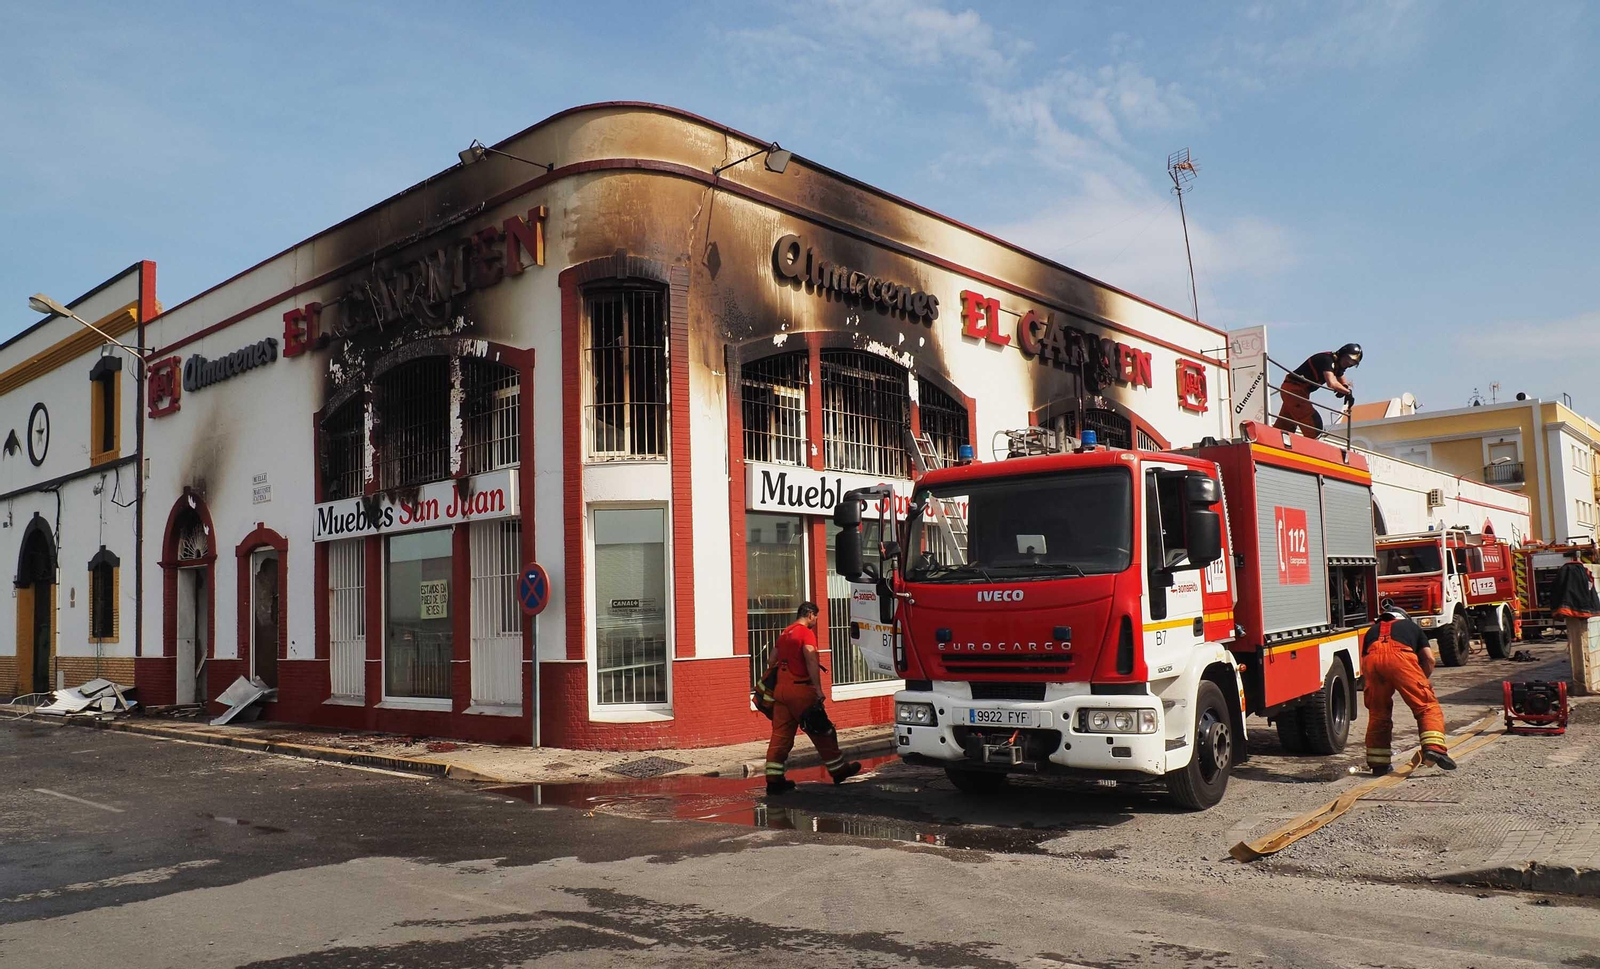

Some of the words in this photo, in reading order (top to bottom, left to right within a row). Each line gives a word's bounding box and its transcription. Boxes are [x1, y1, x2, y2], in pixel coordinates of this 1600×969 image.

[960, 290, 1011, 346] EL
[283, 302, 330, 358] EL
[1289, 528, 1305, 553] 112
[1213, 560, 1224, 574] 112
[977, 589, 1024, 602] IVECO
[883, 634, 892, 647] B7
[1156, 631, 1167, 645] B7
[938, 642, 1071, 650] EUROCARGO
[977, 711, 1002, 722] 9922
[1008, 712, 1027, 723] FYF
